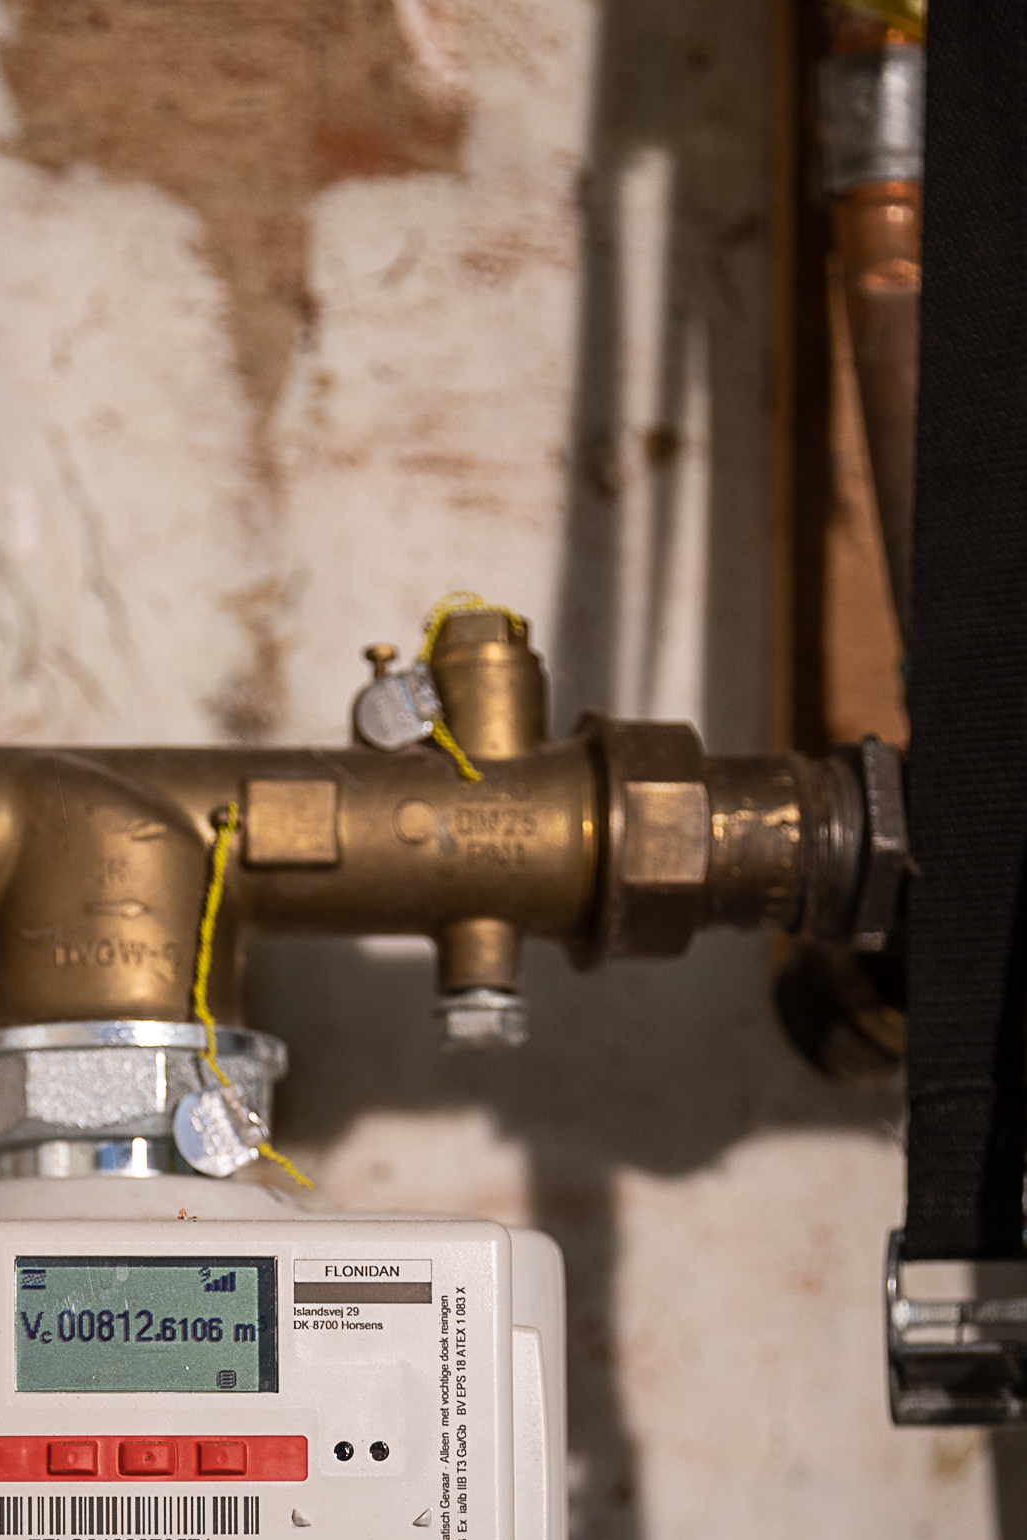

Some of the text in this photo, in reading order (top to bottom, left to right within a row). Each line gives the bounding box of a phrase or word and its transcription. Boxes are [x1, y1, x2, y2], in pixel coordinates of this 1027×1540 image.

[324, 1266, 400, 1277] FLONIDAN
[456, 1286, 466, 1294] X
[293, 1307, 359, 1318] Islandsvej 29
[440, 1295, 452, 1335] reinigen
[456, 1297, 466, 1316] 083
[293, 1320, 383, 1330] DK-8700 Horsens
[440, 1337, 449, 1362] doek
[456, 1329, 466, 1357] ATEX
[456, 1360, 466, 1372] 18
[440, 1364, 452, 1401] vochtige
[456, 1375, 466, 1398] EPS
[440, 1408, 449, 1426] met
[456, 1400, 466, 1416] BV
[440, 1432, 449, 1463] Alleen
[457, 1424, 467, 1458] Ga/Gb
[457, 1460, 467, 1474] T3
[440, 1472, 450, 1509] Gevaar
[458, 1520, 467, 1532] Ex
